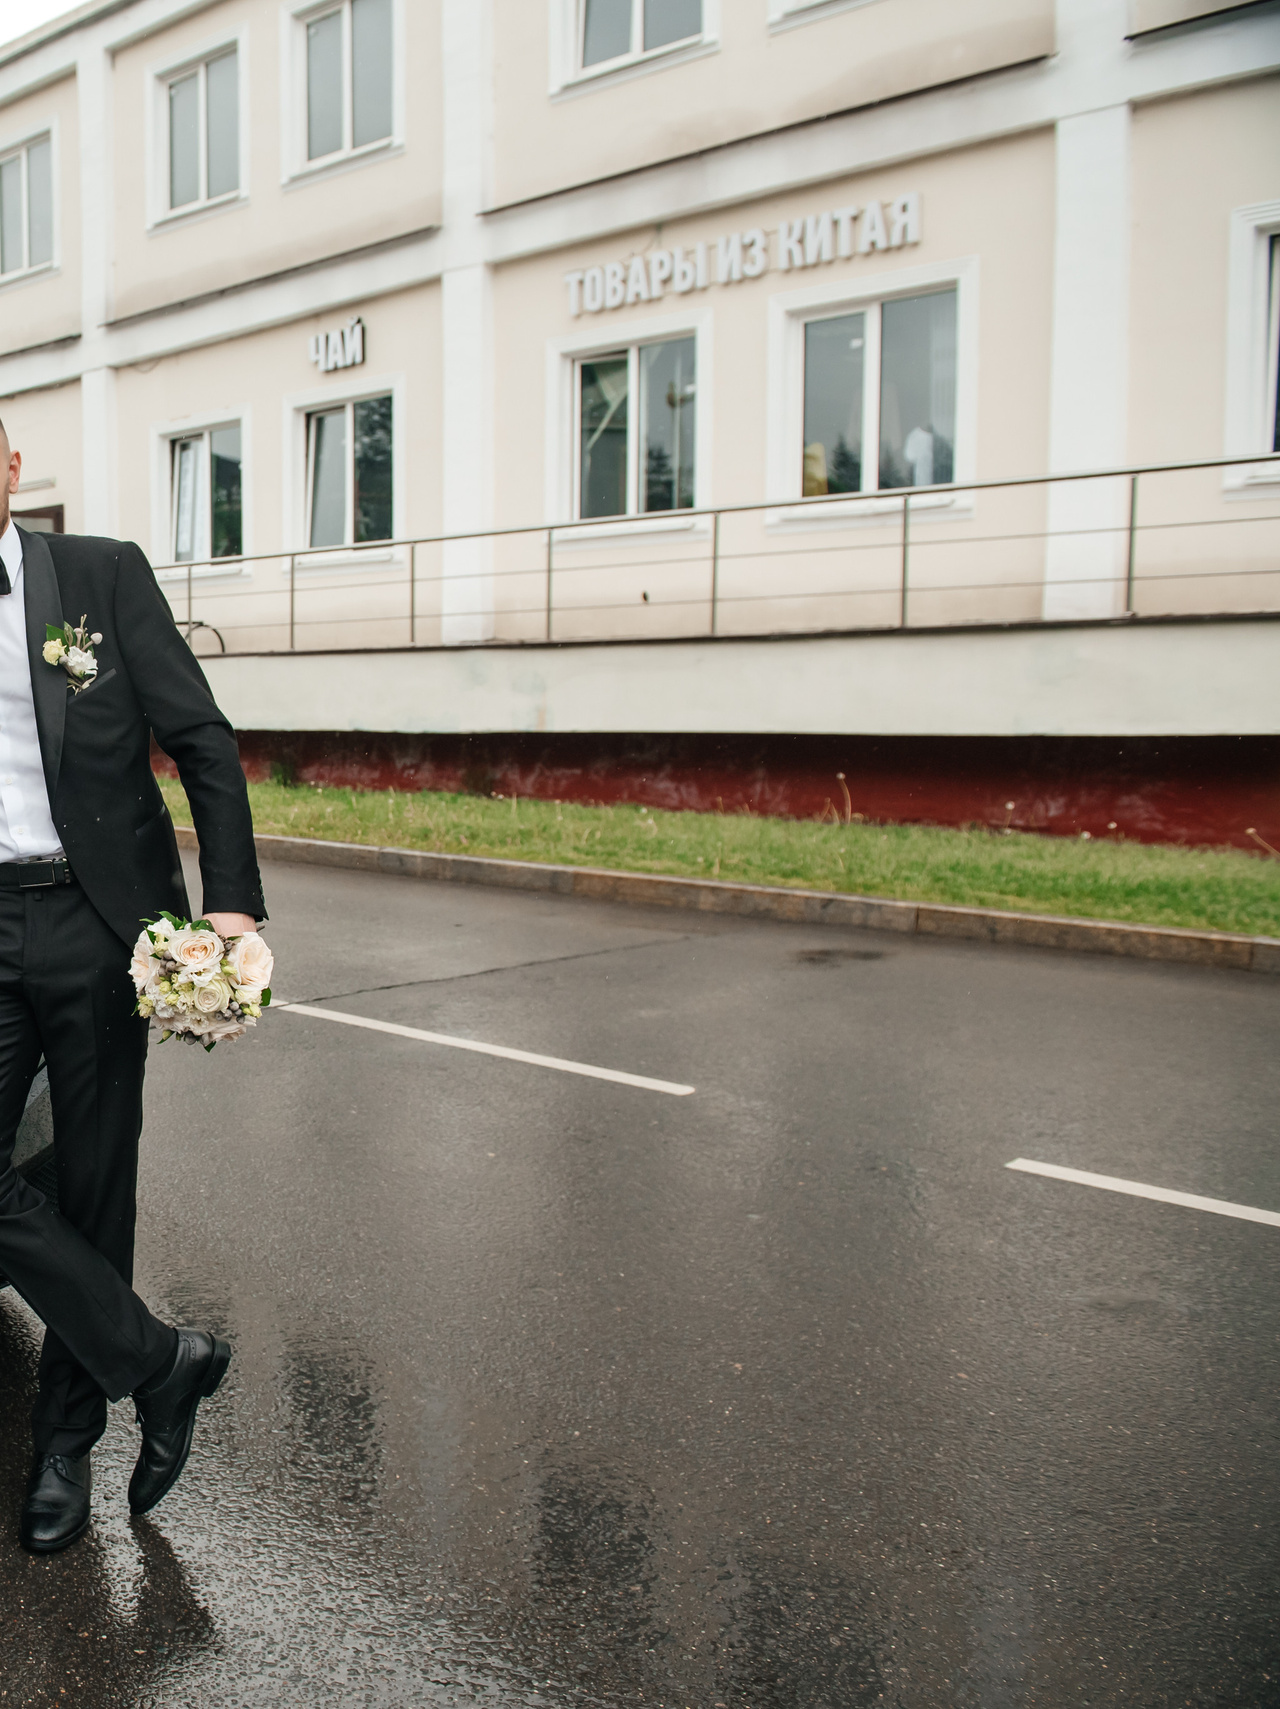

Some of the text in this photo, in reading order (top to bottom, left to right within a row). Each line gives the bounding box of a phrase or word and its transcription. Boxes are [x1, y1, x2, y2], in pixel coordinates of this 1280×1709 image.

[564, 191, 920, 316] ТОВАРЫ ИЗ КИТАЯ
[308, 316, 364, 372] ЧАЙ
